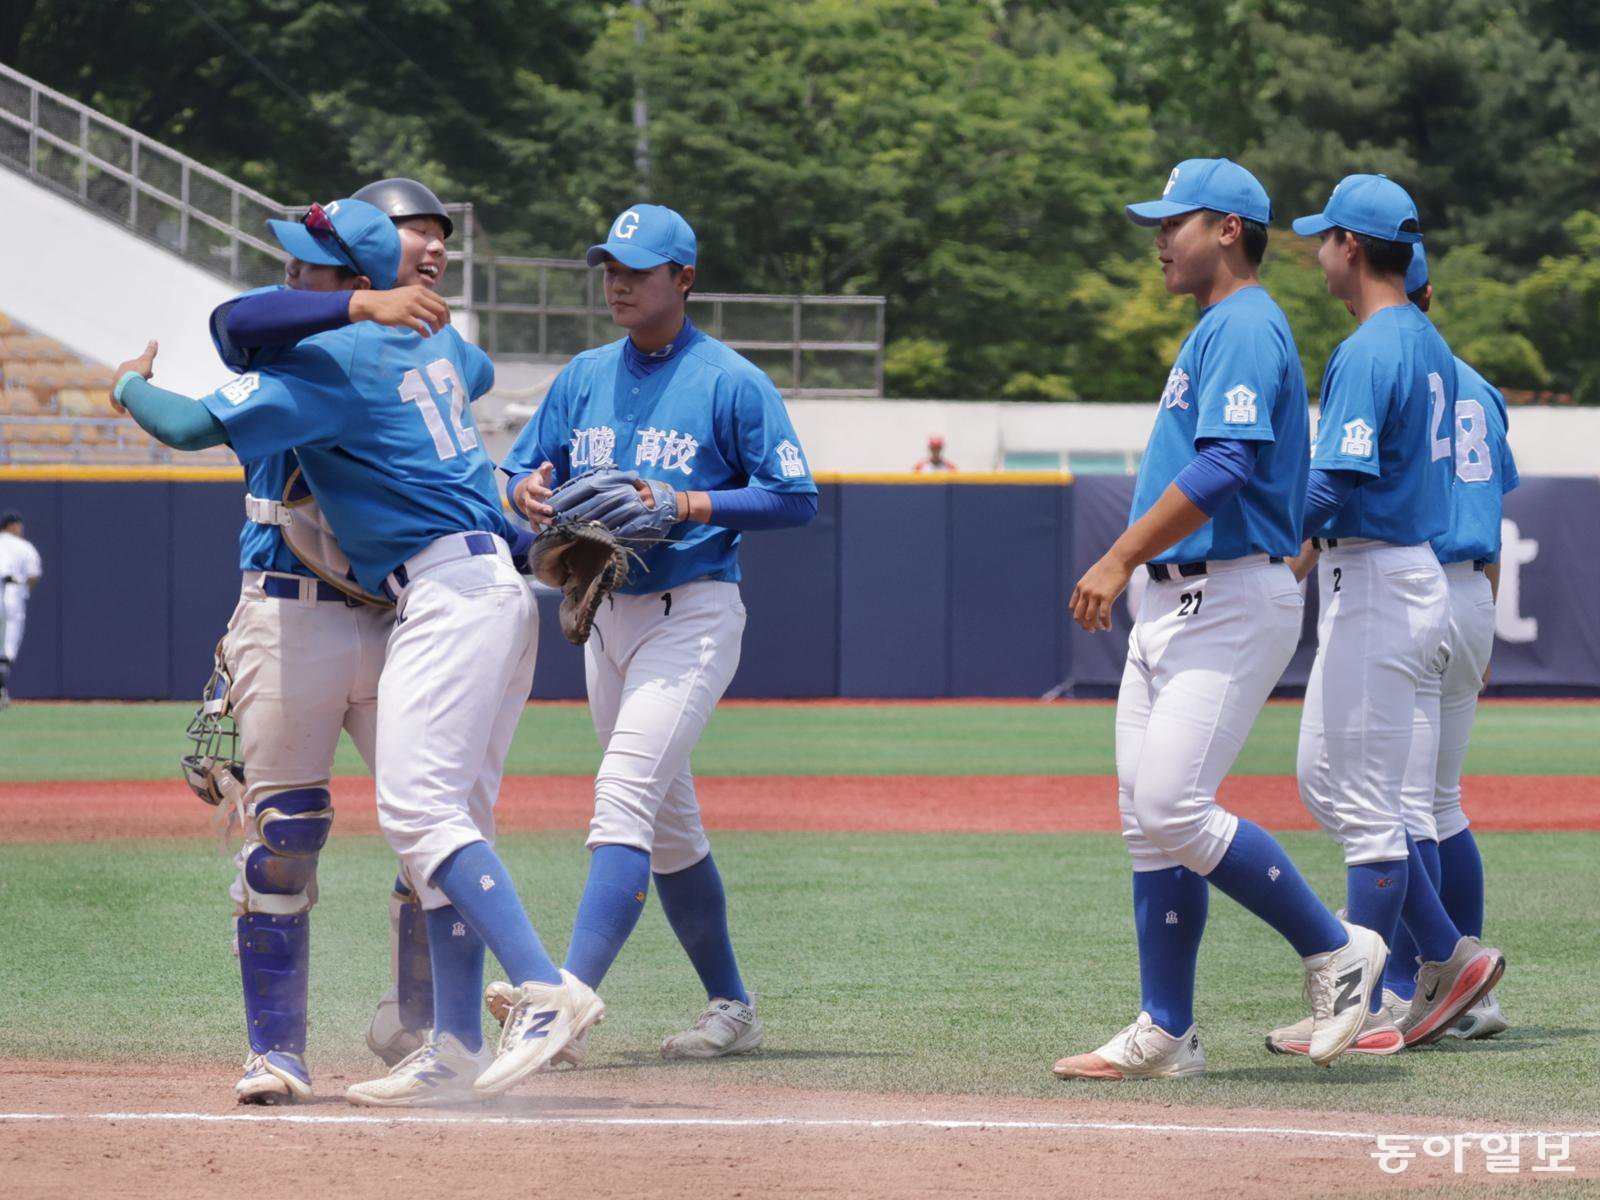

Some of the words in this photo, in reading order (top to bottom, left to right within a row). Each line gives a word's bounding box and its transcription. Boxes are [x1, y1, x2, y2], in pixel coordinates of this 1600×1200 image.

[615, 211, 640, 239] G
[397, 358, 478, 461] 12
[1455, 400, 1493, 482] 8
[1333, 568, 1342, 592] 2
[1177, 590, 1203, 616] 21
